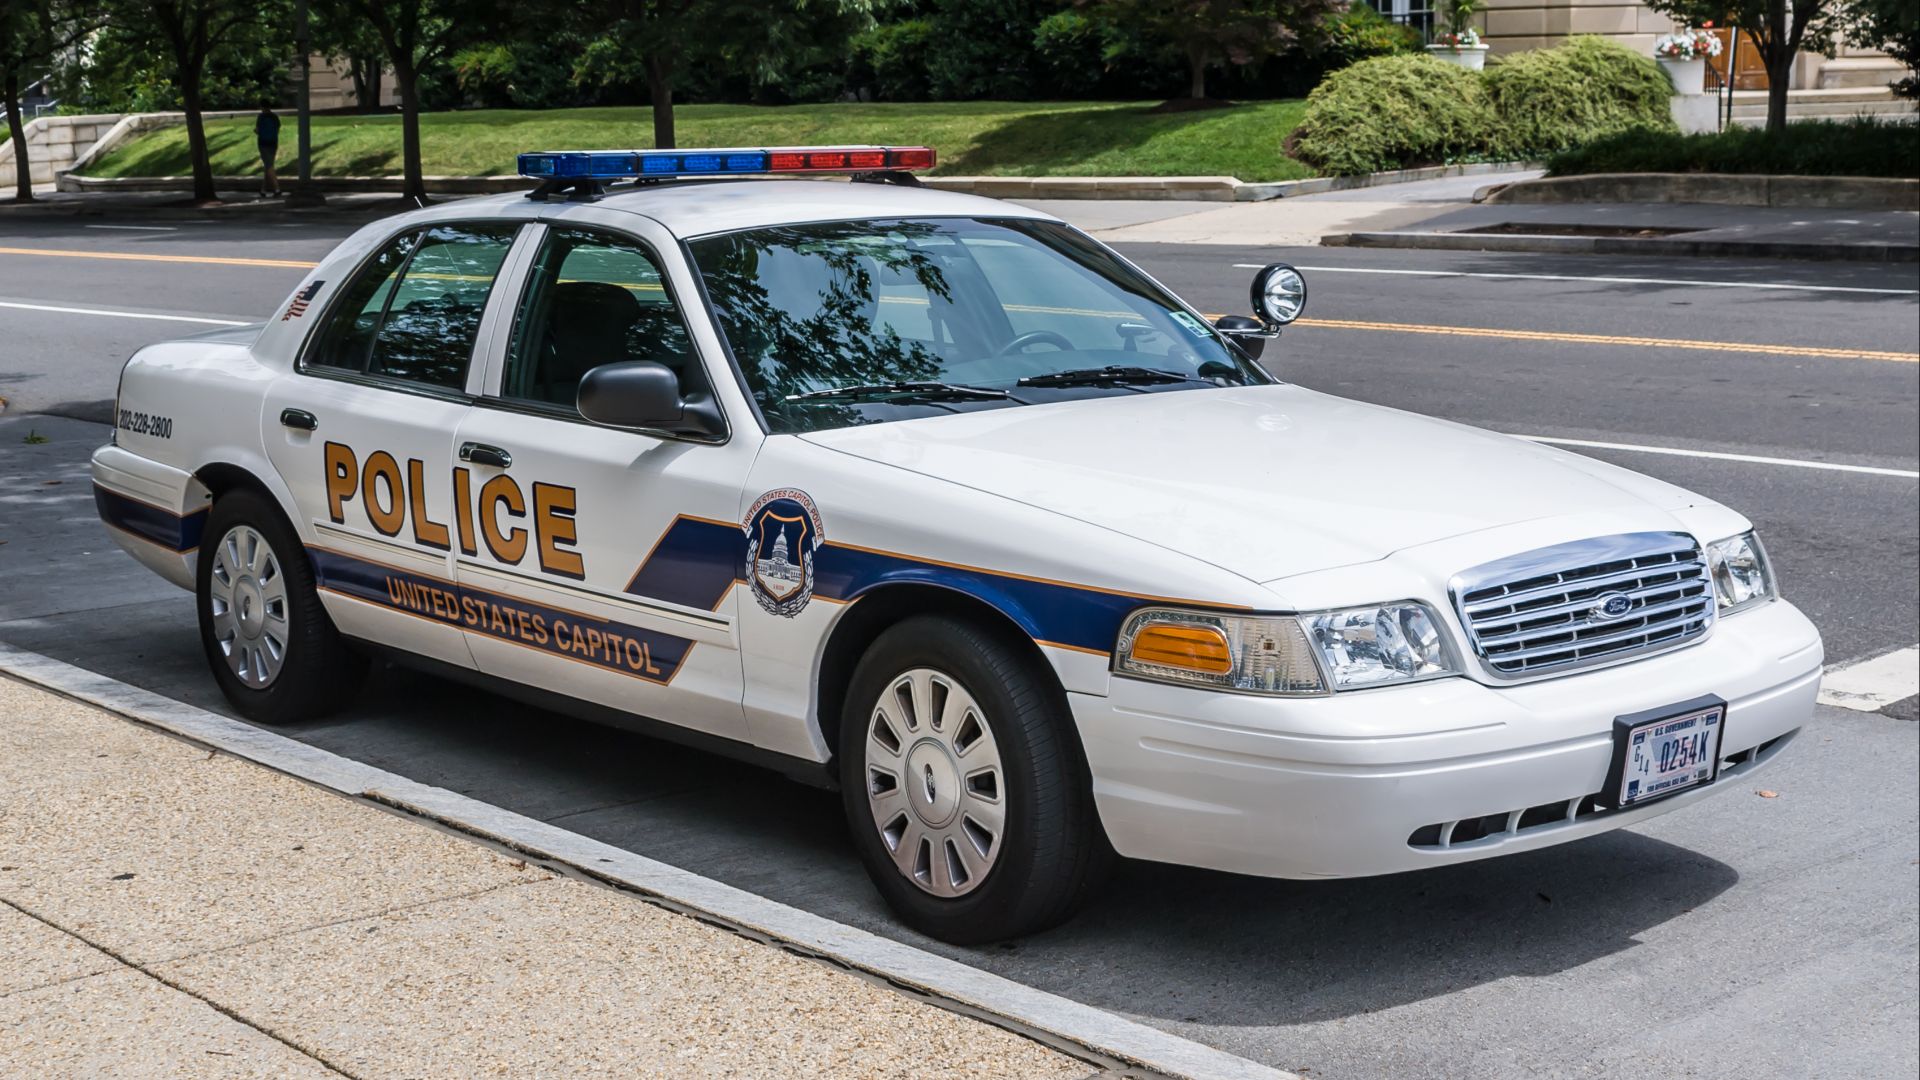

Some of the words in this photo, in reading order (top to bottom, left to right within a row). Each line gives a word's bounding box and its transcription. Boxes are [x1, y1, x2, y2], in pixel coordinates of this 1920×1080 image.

[119, 409, 172, 439] 202-228-2800
[324, 440, 585, 581] POLICE
[742, 500, 762, 529] UNITED
[762, 490, 787, 504] STATES
[788, 490, 812, 511] CAPITOL
[809, 508, 823, 540] POLICE
[386, 576, 460, 620] UNITED
[461, 596, 549, 645] STATES
[553, 619, 660, 675] CAPITOL
[1664, 718, 1698, 734] GOVERNMENT
[1660, 730, 1710, 773] 0254K
